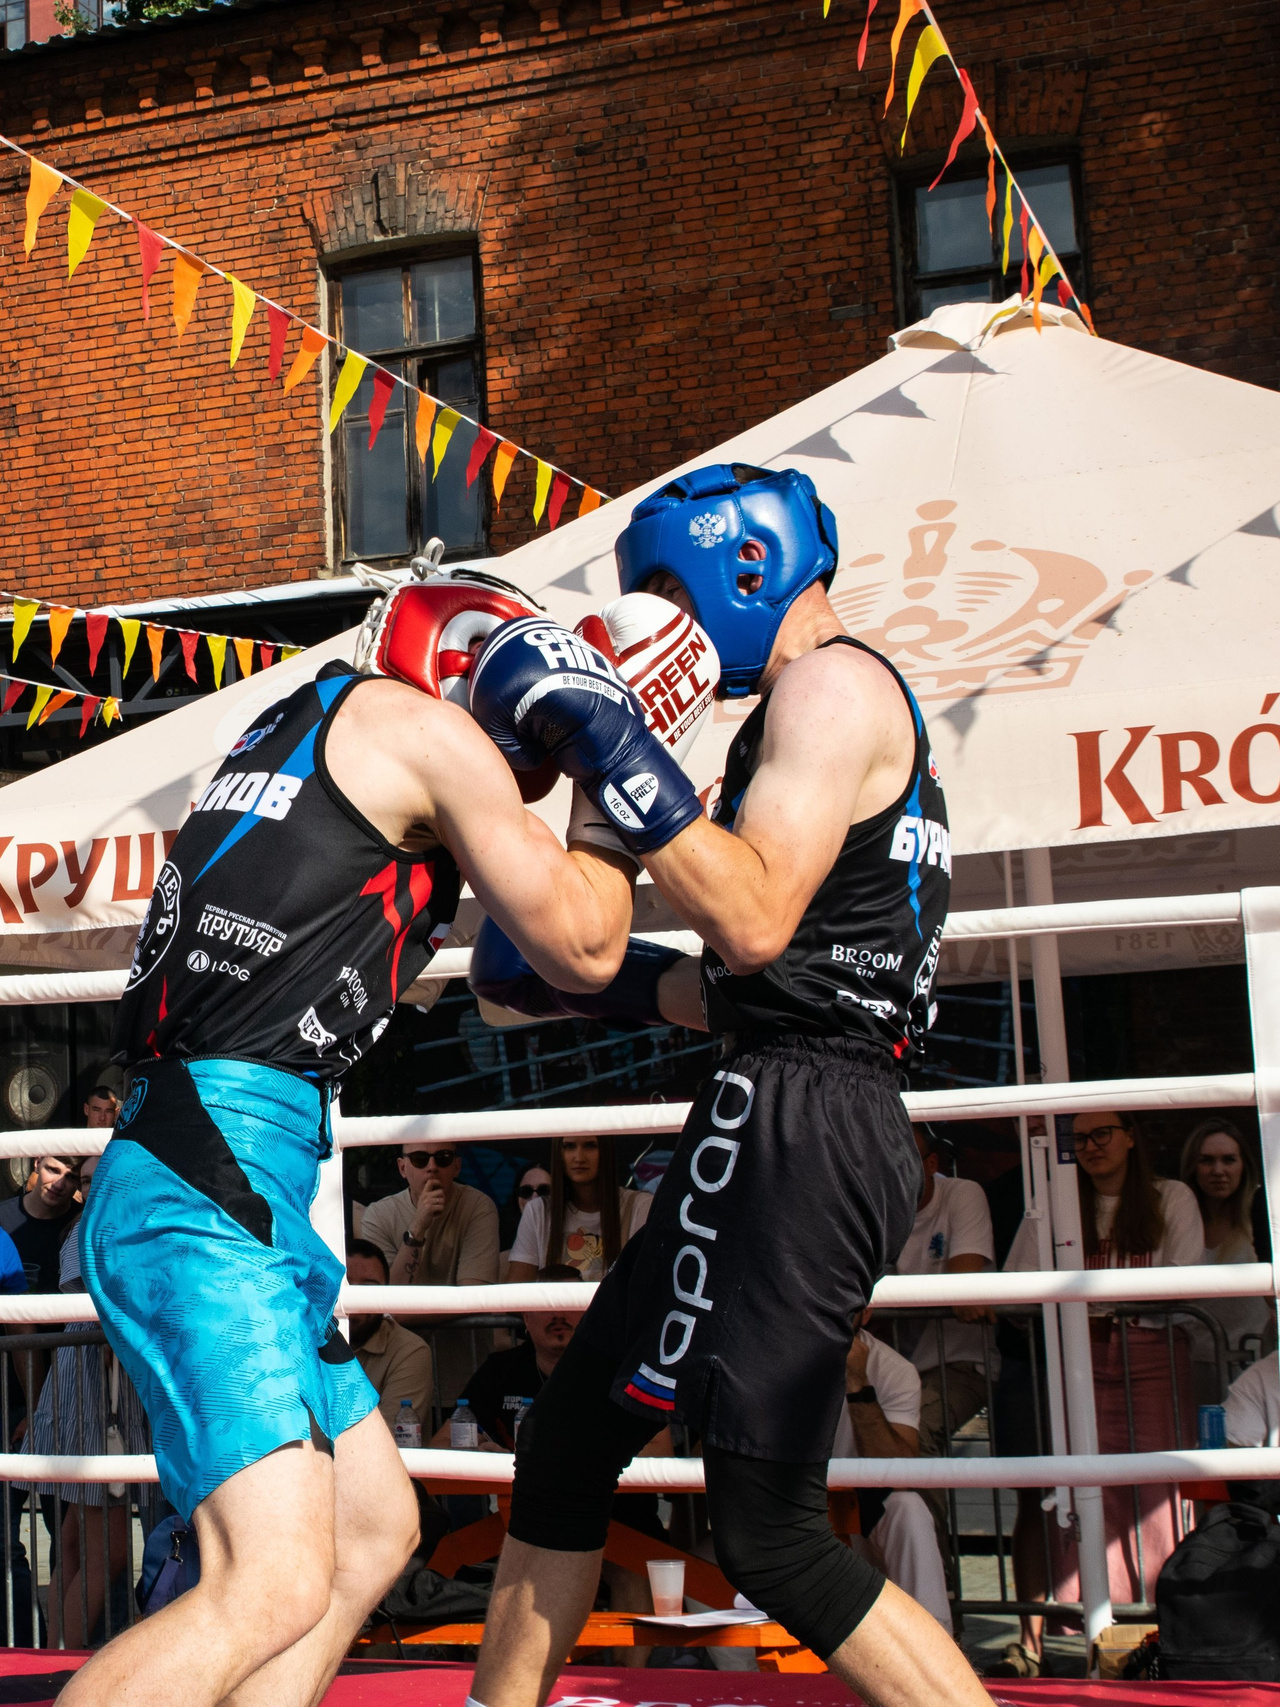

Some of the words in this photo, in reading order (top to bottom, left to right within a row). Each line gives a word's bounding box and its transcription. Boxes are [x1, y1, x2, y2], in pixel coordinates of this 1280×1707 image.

[562, 675, 571, 685] BE
[571, 676, 588, 688] YOUR
[588, 679, 602, 690] BEST
[603, 686, 616, 698] SELF
[673, 727, 682, 741] BE
[680, 714, 694, 732] YOUR
[693, 702, 706, 718] BEST
[630, 775, 656, 797] GREEN
[633, 784, 657, 802] HILL
[205, 903, 228, 917] ПЕРВАЯ
[228, 911, 256, 926] РУССКАЯ
[830, 943, 904, 972] BROOM
[855, 967, 876, 979] GIN
[336, 966, 369, 1015] BROOM
[339, 991, 351, 1008] GIN
